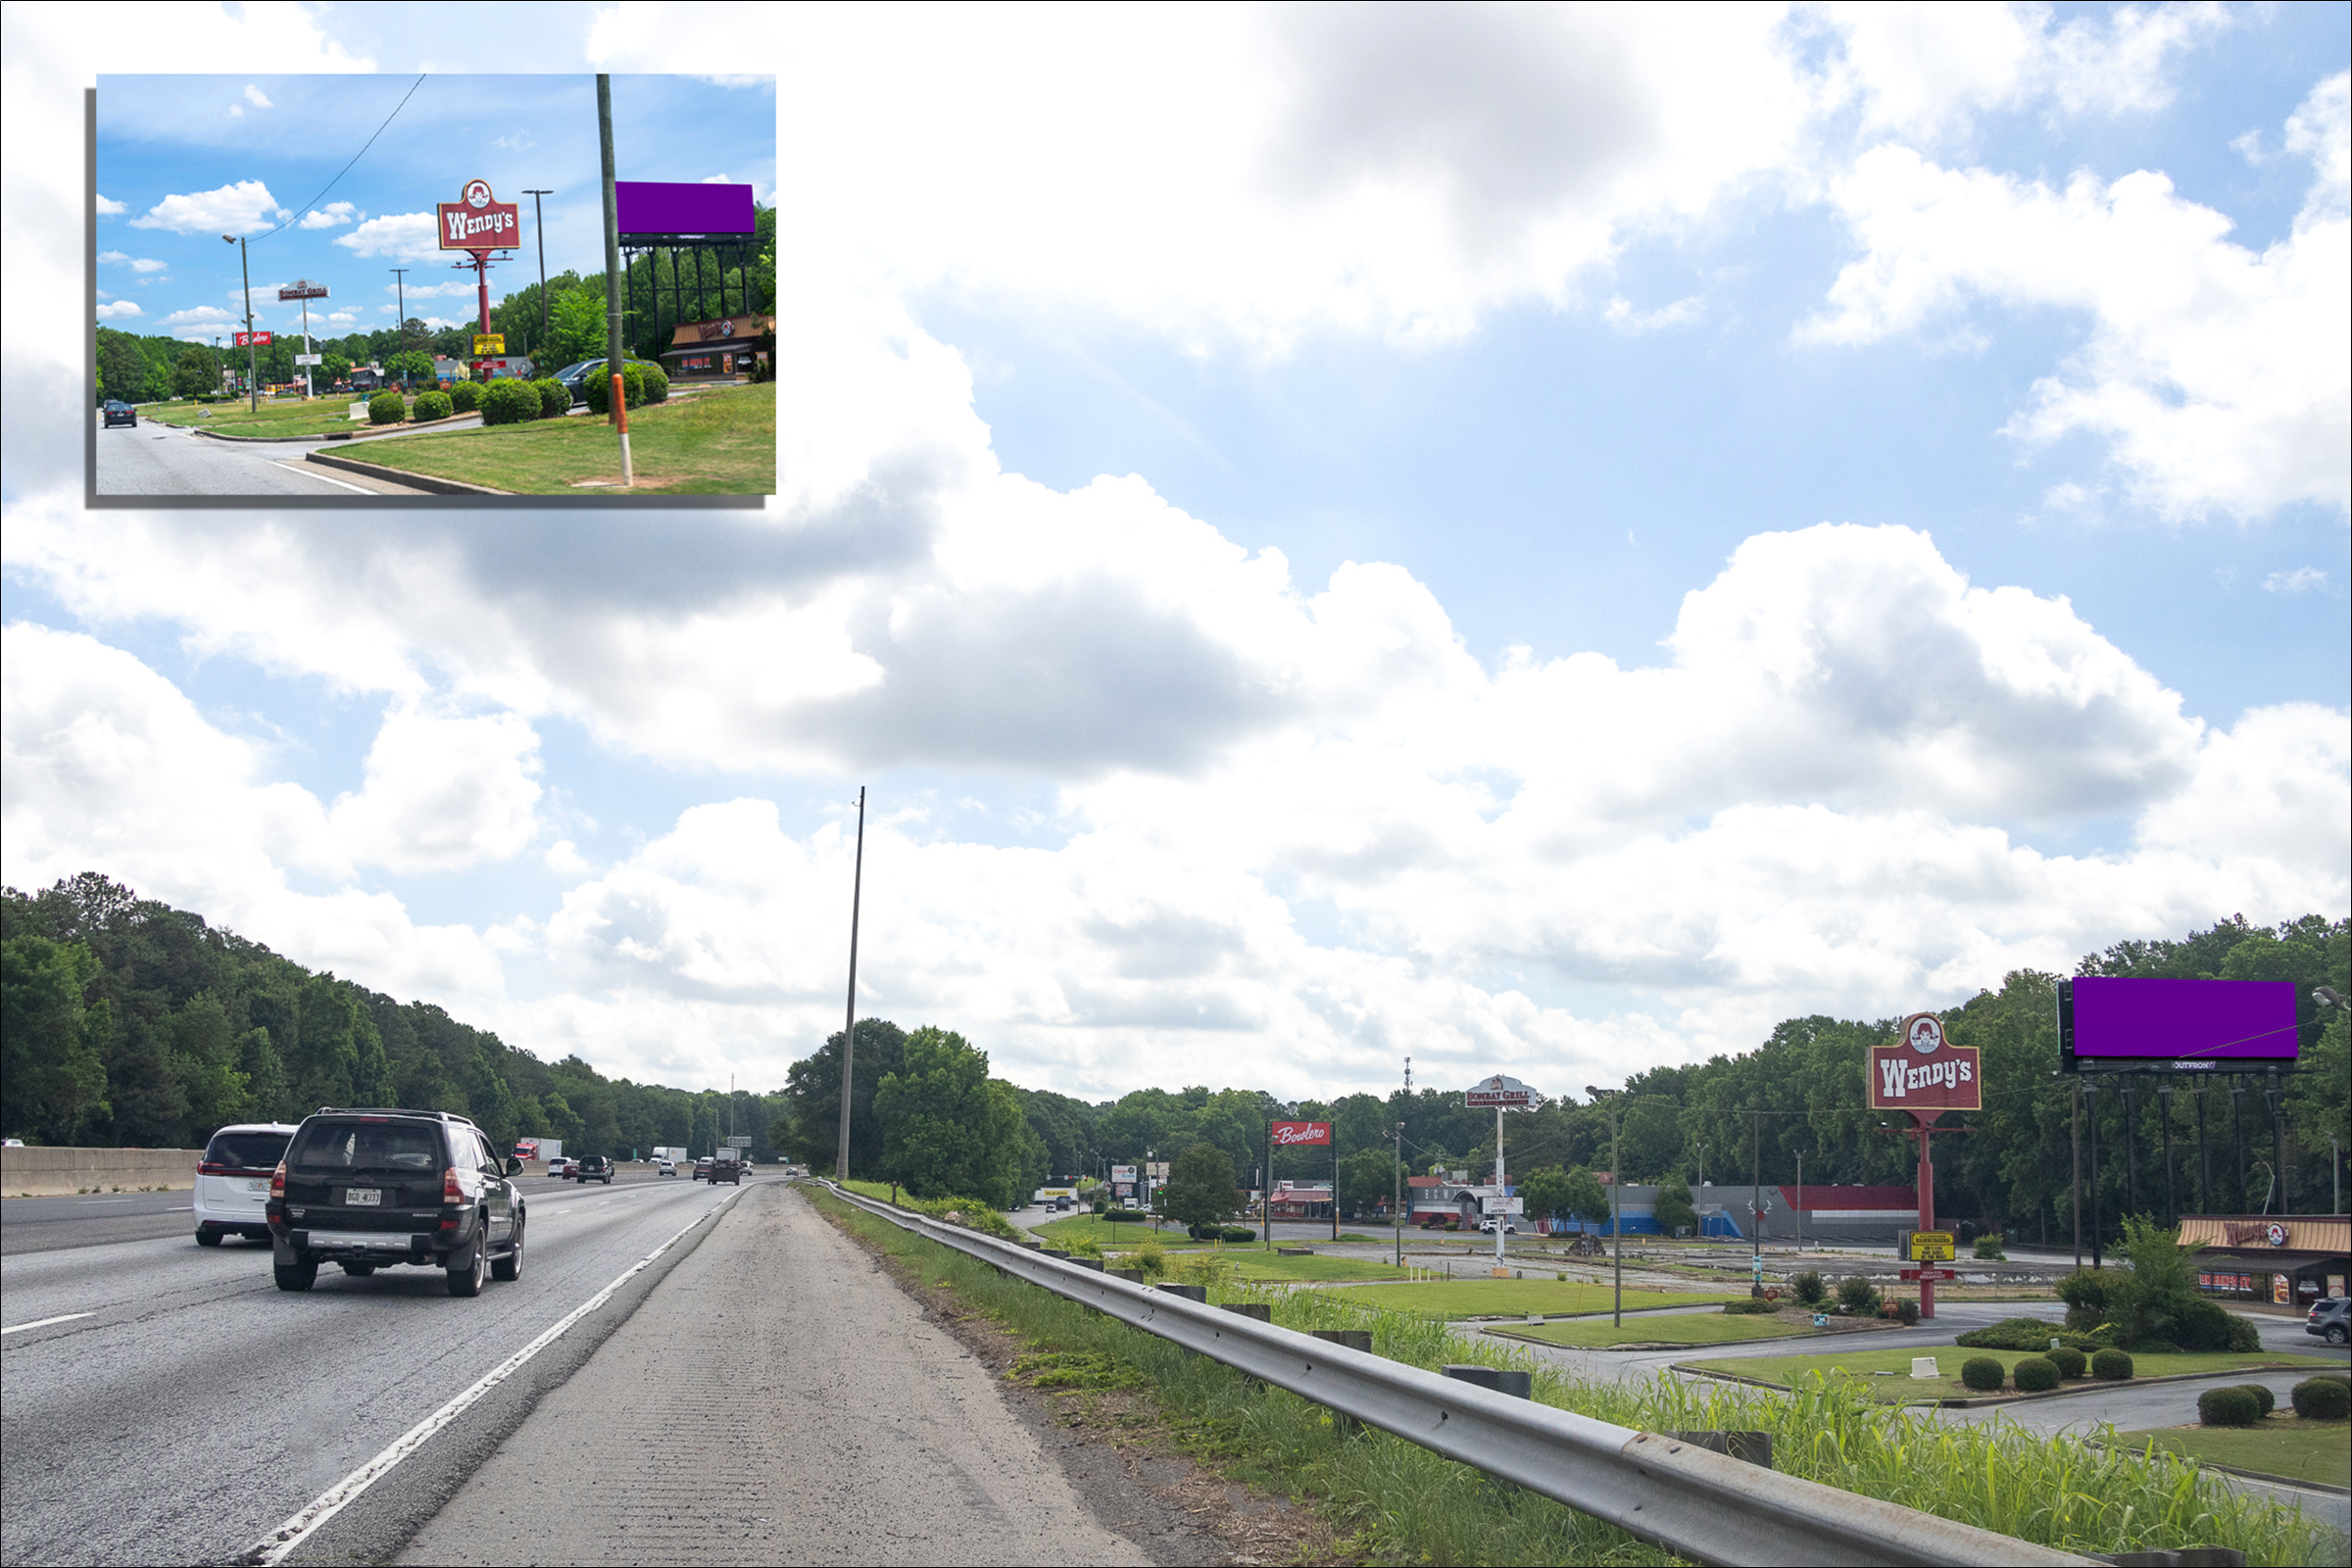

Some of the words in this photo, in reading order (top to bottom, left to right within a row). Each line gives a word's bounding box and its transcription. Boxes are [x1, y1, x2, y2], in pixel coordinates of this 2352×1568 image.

[446, 211, 514, 240] Wendy's
[1880, 1058, 1973, 1097] Wendy's
[1466, 1092, 1501, 1101] BOMBAY
[1502, 1090, 1530, 1100] GRILL
[1277, 1122, 1325, 1145] Bowlero
